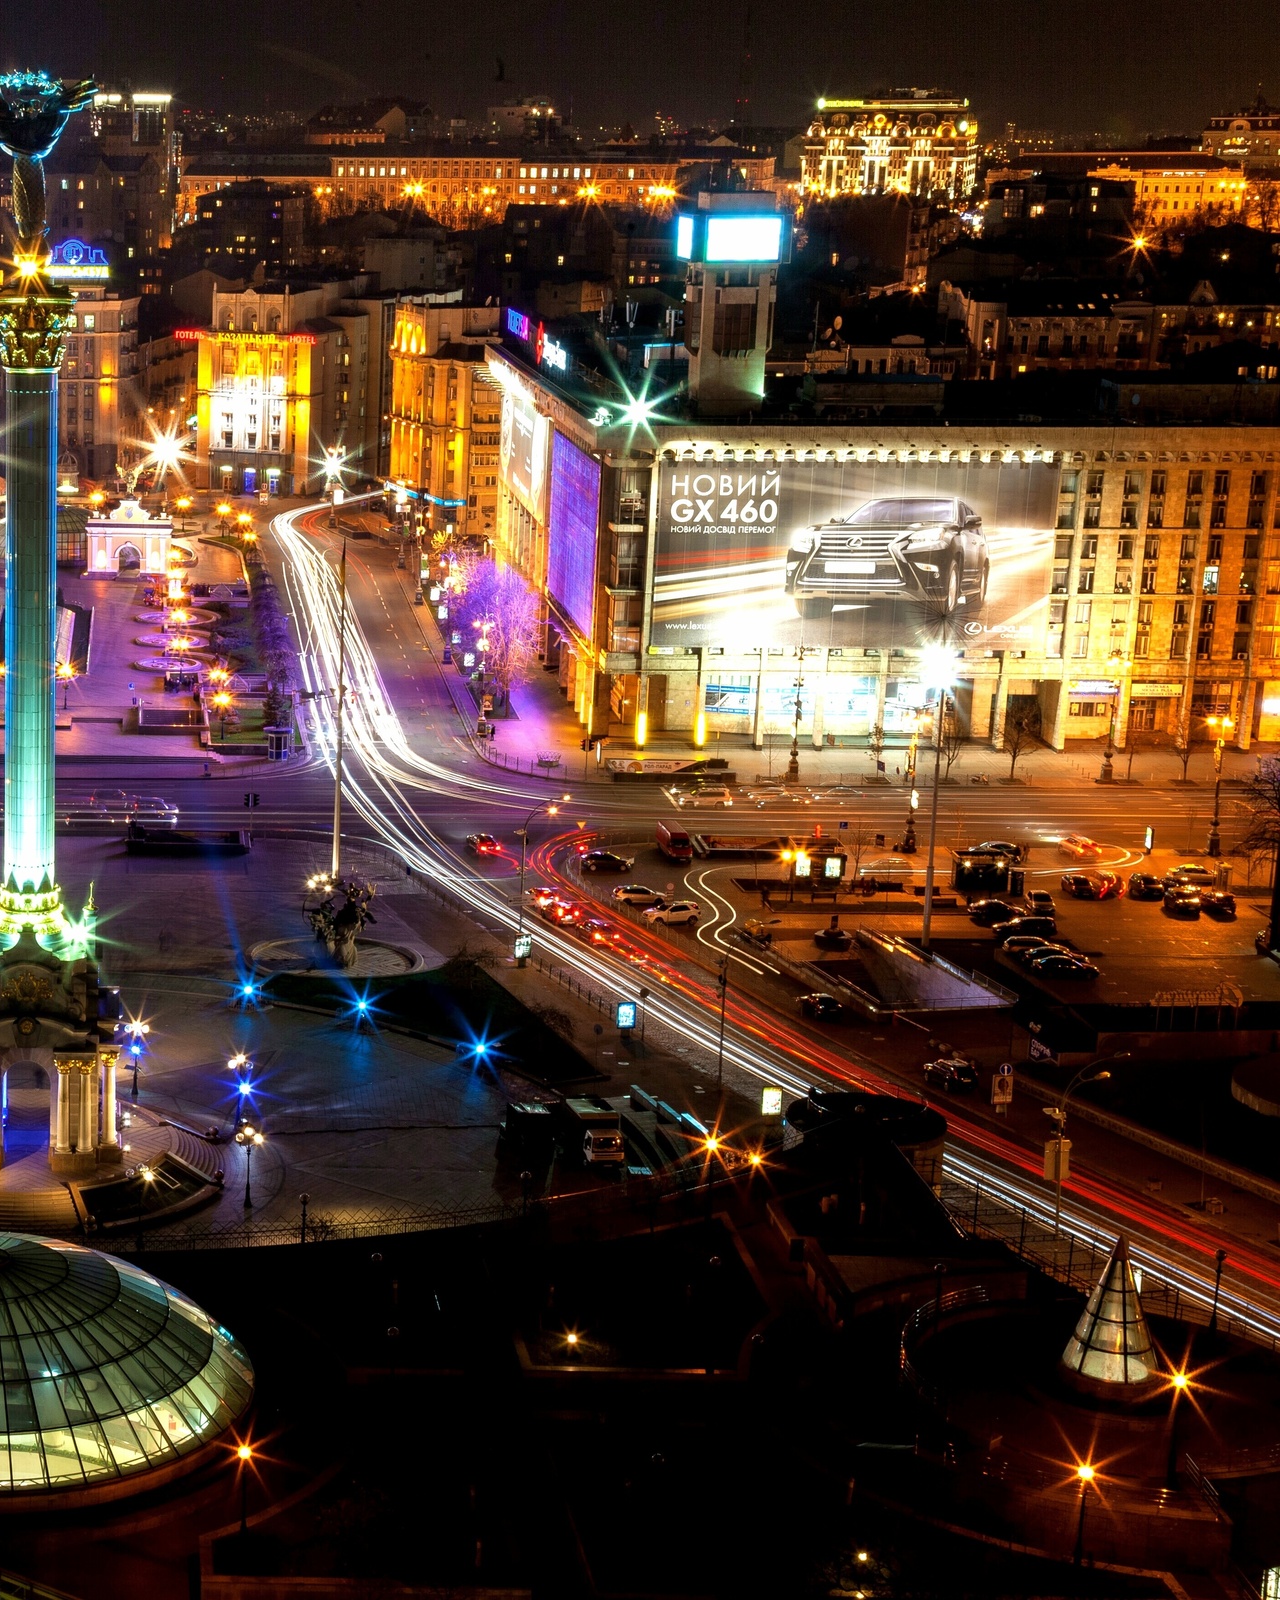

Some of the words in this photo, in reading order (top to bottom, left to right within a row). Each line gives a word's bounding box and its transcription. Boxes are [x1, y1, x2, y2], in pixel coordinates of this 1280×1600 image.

[175, 330, 205, 340] ГОТЕЛЬ
[218, 332, 276, 344] КОЗАЦЬКИЙ
[289, 335, 316, 344] HOTEL
[671, 470, 780, 496] НОВИЙ
[670, 498, 715, 523] GX
[719, 498, 778, 523] 460
[670, 524, 702, 533] НОВИЙ
[703, 525, 736, 534] ДОСВІД
[738, 526, 776, 534] ПЕРЕМОГ
